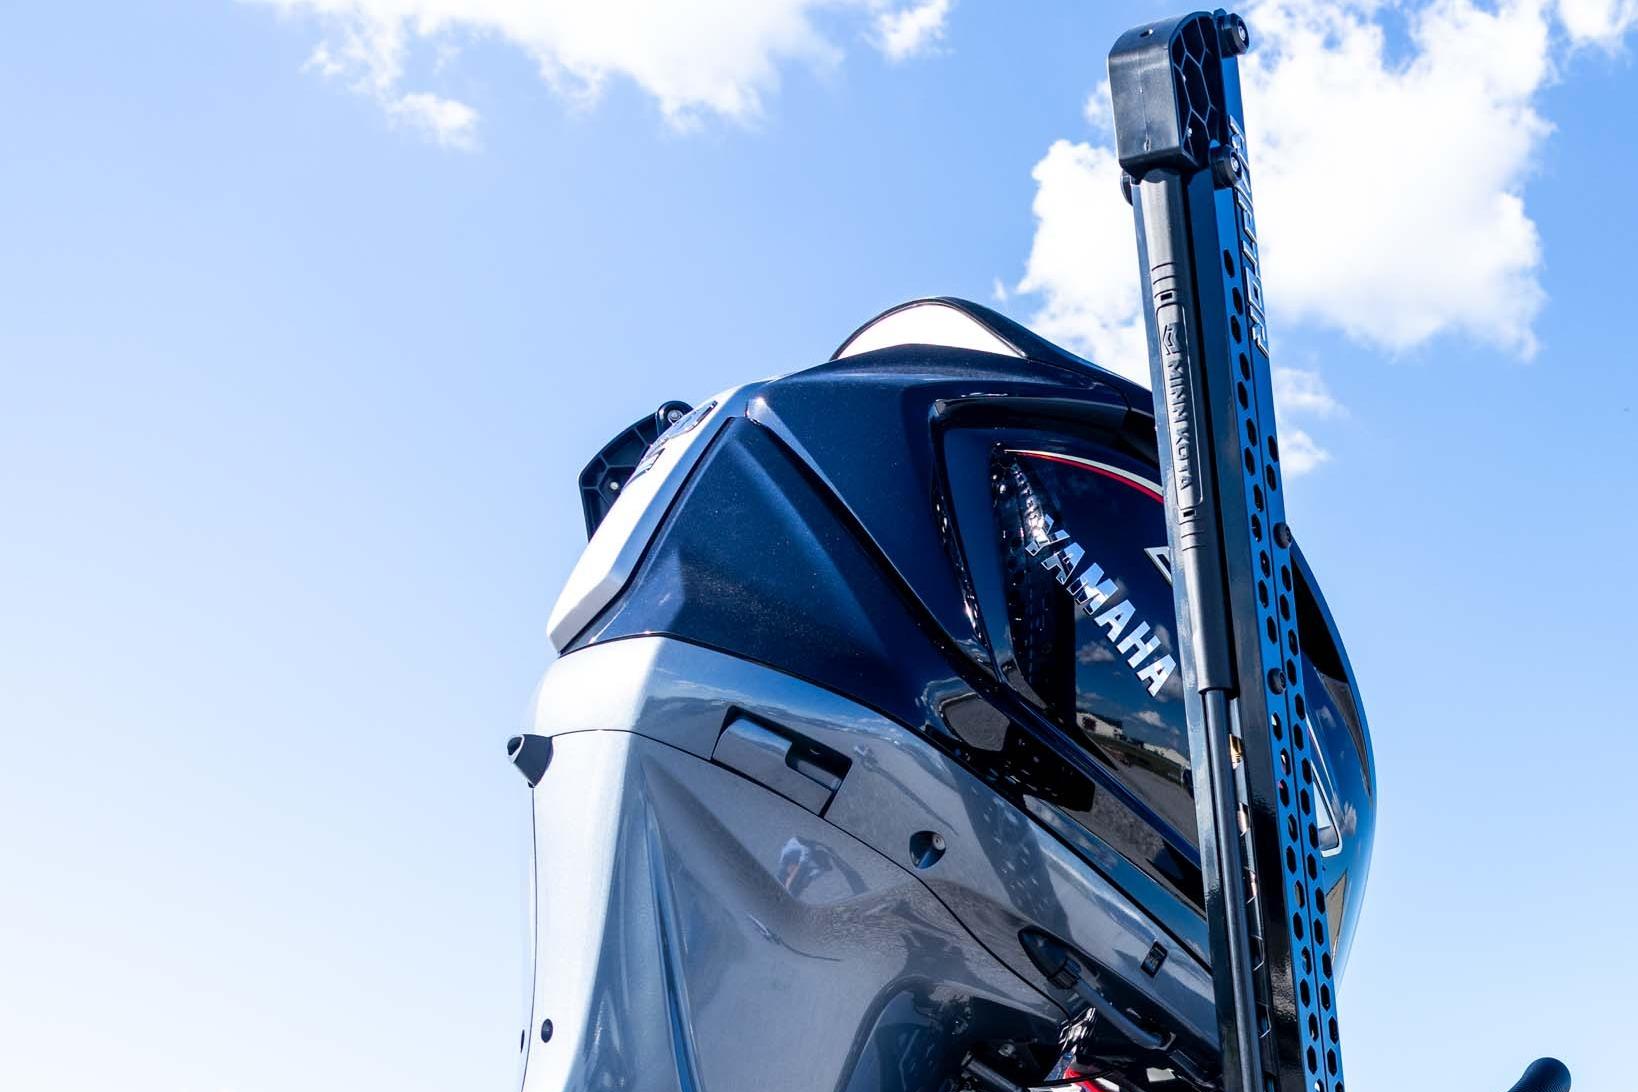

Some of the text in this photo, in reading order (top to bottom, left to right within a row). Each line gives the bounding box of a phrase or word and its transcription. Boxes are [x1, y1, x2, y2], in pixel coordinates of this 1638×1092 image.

[1168, 358, 1193, 490] MINN KOTA
[1025, 513, 1177, 697] YAMAHA
